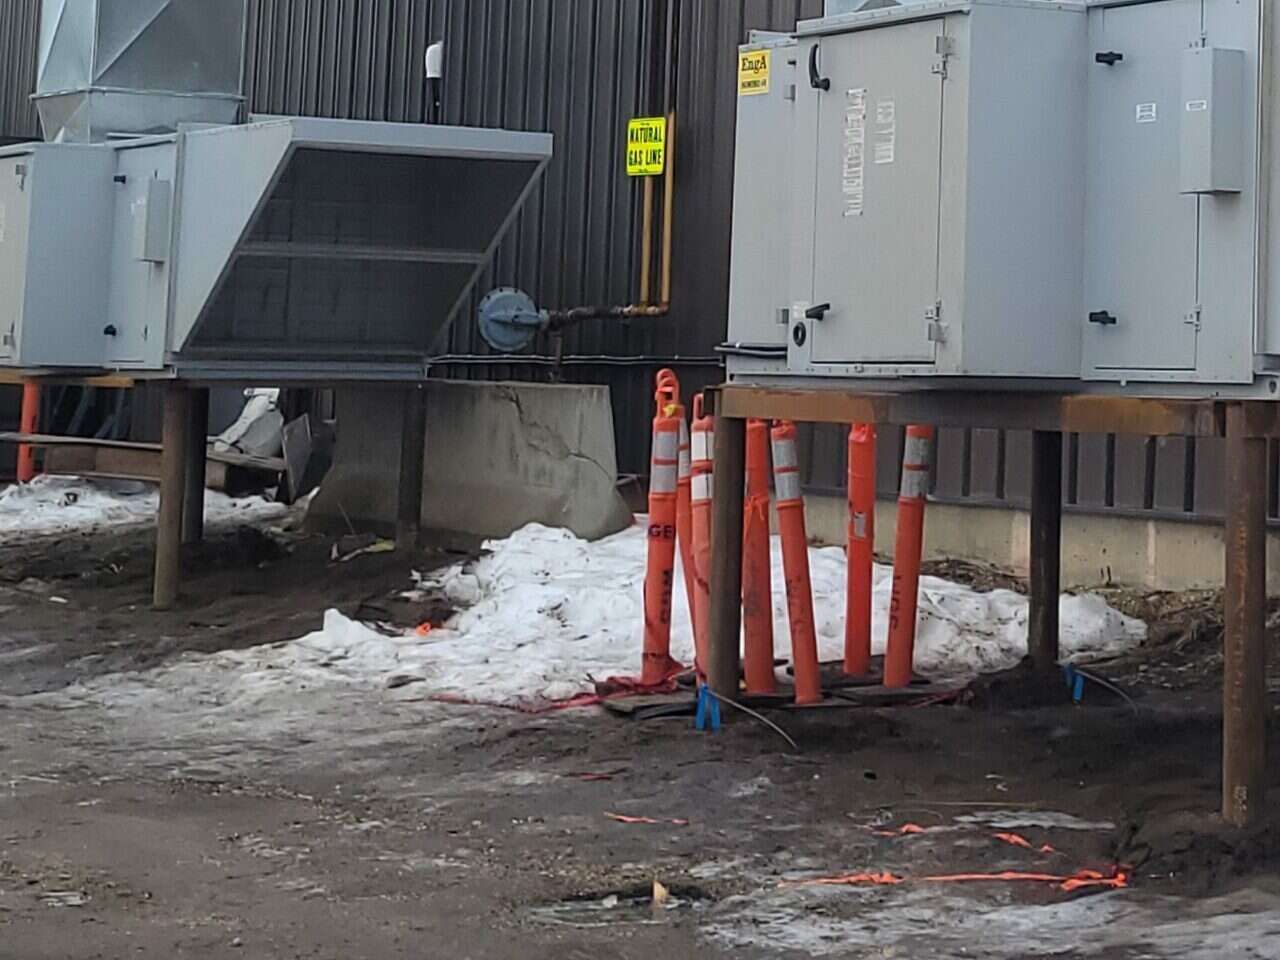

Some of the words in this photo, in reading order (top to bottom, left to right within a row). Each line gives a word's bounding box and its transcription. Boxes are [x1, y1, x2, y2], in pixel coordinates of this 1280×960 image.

[741, 55, 767, 74] EngA
[630, 126, 662, 144] NATURAL
[629, 150, 643, 166] GAS
[645, 149, 662, 165] LINE
